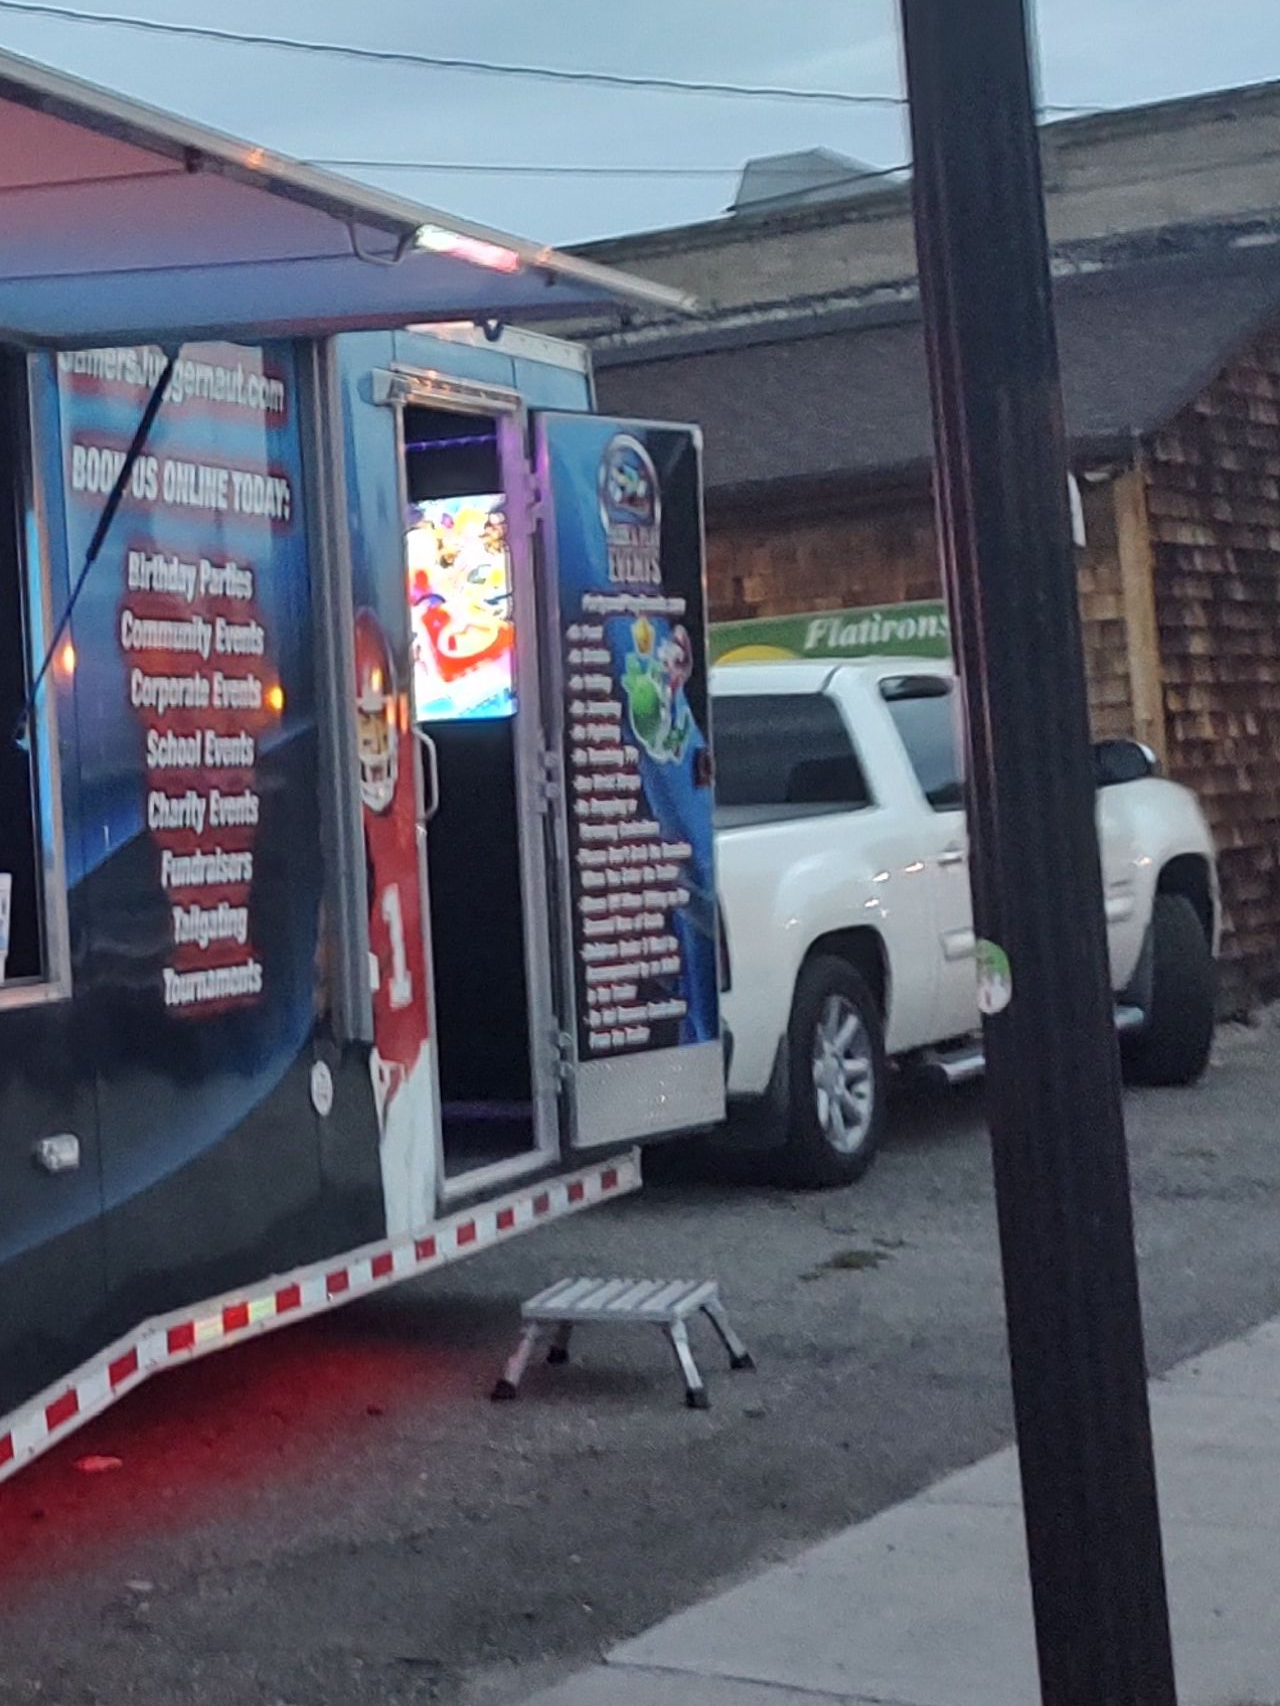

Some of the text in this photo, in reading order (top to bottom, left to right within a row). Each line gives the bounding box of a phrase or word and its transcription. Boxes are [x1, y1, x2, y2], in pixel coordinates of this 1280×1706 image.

[58, 346, 285, 413] amersJugernaut.com
[131, 456, 158, 501] US
[163, 460, 229, 511] ONLINE
[127, 550, 253, 604] Birthday Parties
[120, 609, 265, 661] Community Events
[130, 667, 262, 716] Corporate Events
[147, 728, 255, 769] School Events
[147, 788, 260, 835] Charity Events
[160, 846, 254, 889] Fundraisers
[172, 901, 249, 950] Tailgating
[162, 957, 263, 1006] Tournaments
